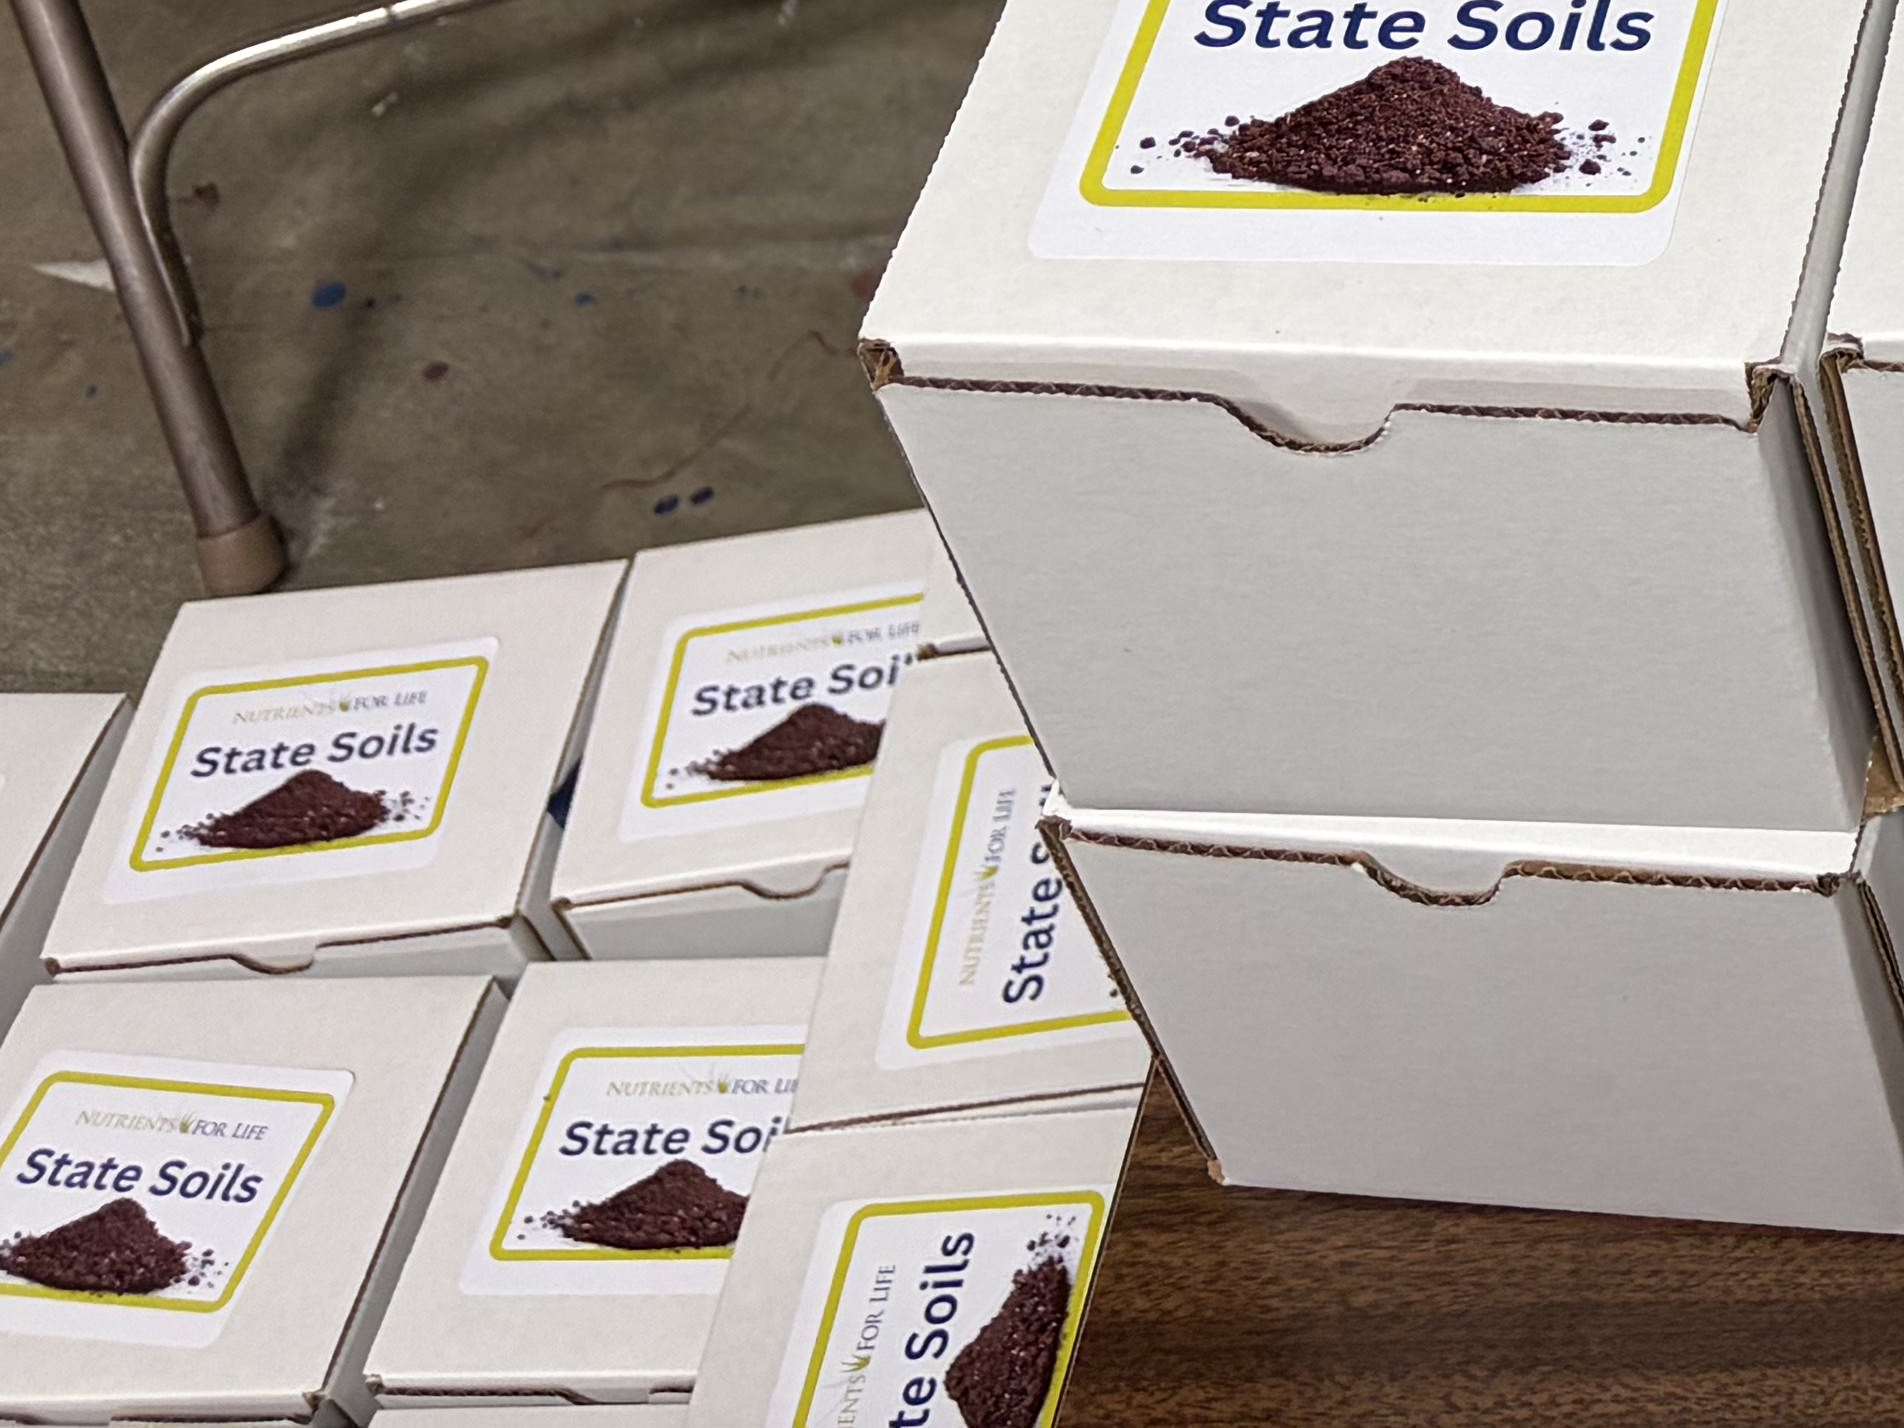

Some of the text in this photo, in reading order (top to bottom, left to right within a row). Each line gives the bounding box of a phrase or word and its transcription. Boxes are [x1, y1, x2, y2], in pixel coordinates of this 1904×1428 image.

[352, 694, 389, 710] FOR
[393, 690, 429, 708] LIFE
[691, 654, 913, 716] State Soi
[190, 721, 439, 778] State Soils
[983, 826, 1008, 863] FOR
[1001, 875, 1064, 1005] State
[605, 1079, 716, 1098] NUTRIENTS
[730, 1079, 770, 1095] FOR
[74, 1110, 269, 1141] NUTRIENTS FOR LIFE
[558, 1116, 783, 1157] State Soi
[16, 1147, 265, 1204] State Soils
[857, 1264, 896, 1351] FOR LIFE
[904, 1232, 976, 1361] Soils
